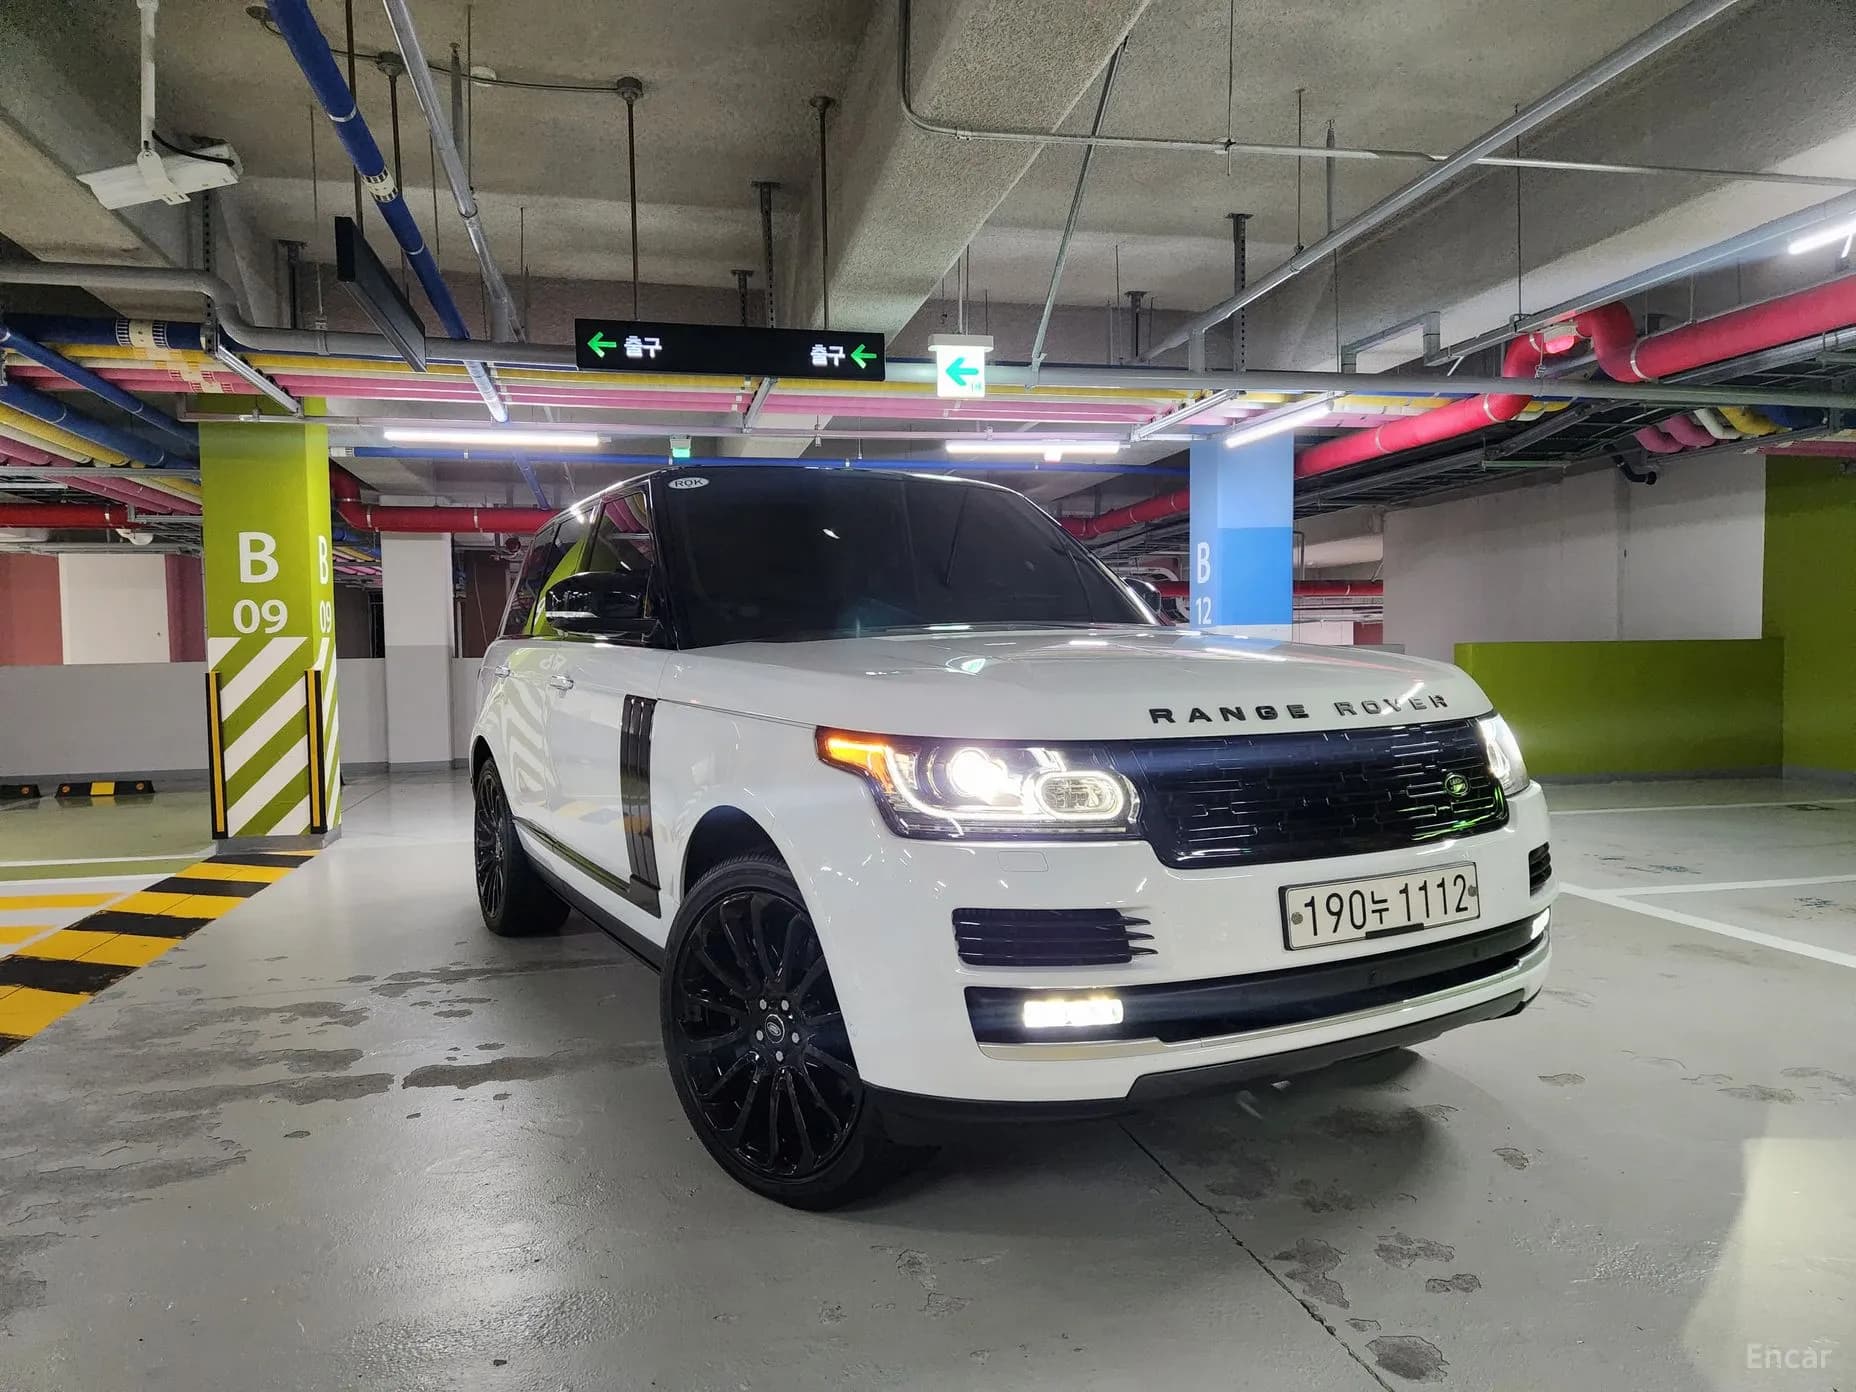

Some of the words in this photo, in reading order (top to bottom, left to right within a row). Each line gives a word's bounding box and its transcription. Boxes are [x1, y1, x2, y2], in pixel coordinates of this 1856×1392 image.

[624, 334, 663, 359] 출구
[810, 343, 846, 367] 출구
[238, 531, 280, 584] B
[318, 535, 329, 585] B
[1197, 541, 1211, 584] B
[232, 599, 288, 634] 09
[319, 599, 332, 634] 09
[1195, 596, 1212, 625] 12
[1148, 703, 1310, 724] RANGE
[1334, 694, 1449, 716] ROVER
